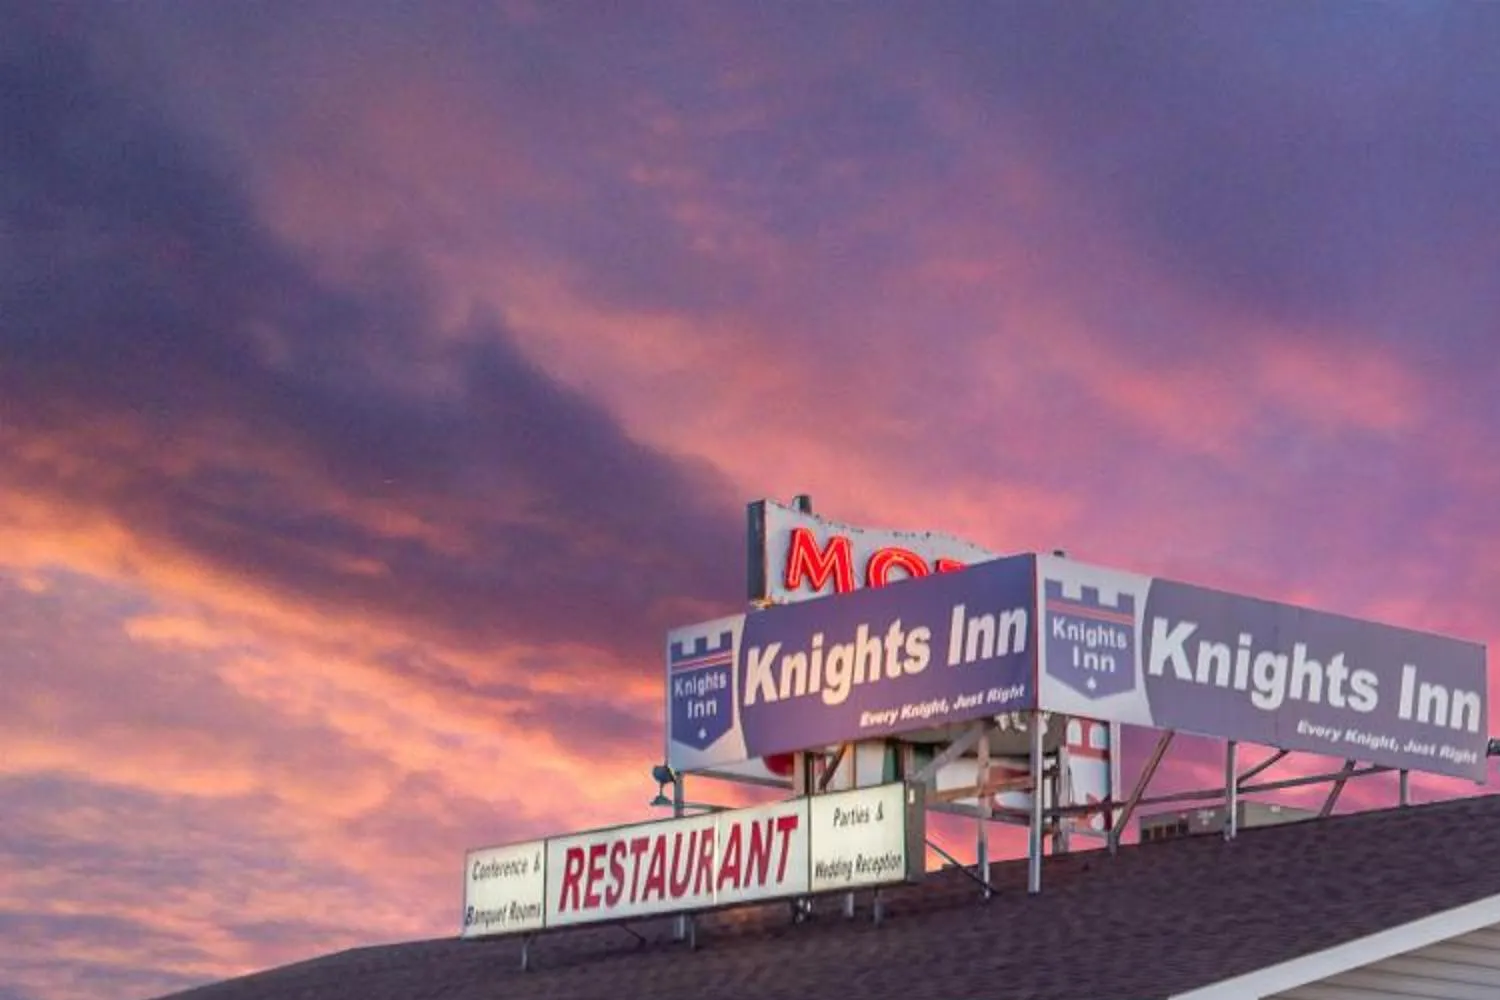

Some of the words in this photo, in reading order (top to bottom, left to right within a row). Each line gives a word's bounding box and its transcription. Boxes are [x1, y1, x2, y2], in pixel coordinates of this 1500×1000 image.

[784, 527, 968, 594] MO
[1052, 617, 1128, 650] Knights
[743, 616, 931, 705] Knights
[947, 603, 1028, 666] Inn
[1072, 649, 1115, 673] Inn
[674, 671, 727, 697] Knights
[1148, 616, 1379, 712] Knights
[1398, 664, 1480, 733] Inn
[687, 700, 717, 719] Inn
[860, 708, 899, 727] Every
[901, 698, 949, 719] Knight,
[953, 691, 985, 710] Just
[987, 684, 1025, 703] Right
[1297, 719, 1341, 742] Every
[1345, 729, 1399, 753] Knight,
[1404, 739, 1437, 756] Just
[1440, 745, 1477, 764] Right
[833, 806, 870, 827] Parties
[472, 858, 528, 880] Conference
[558, 815, 798, 912] RESTAURANT
[856, 852, 902, 875] Reception
